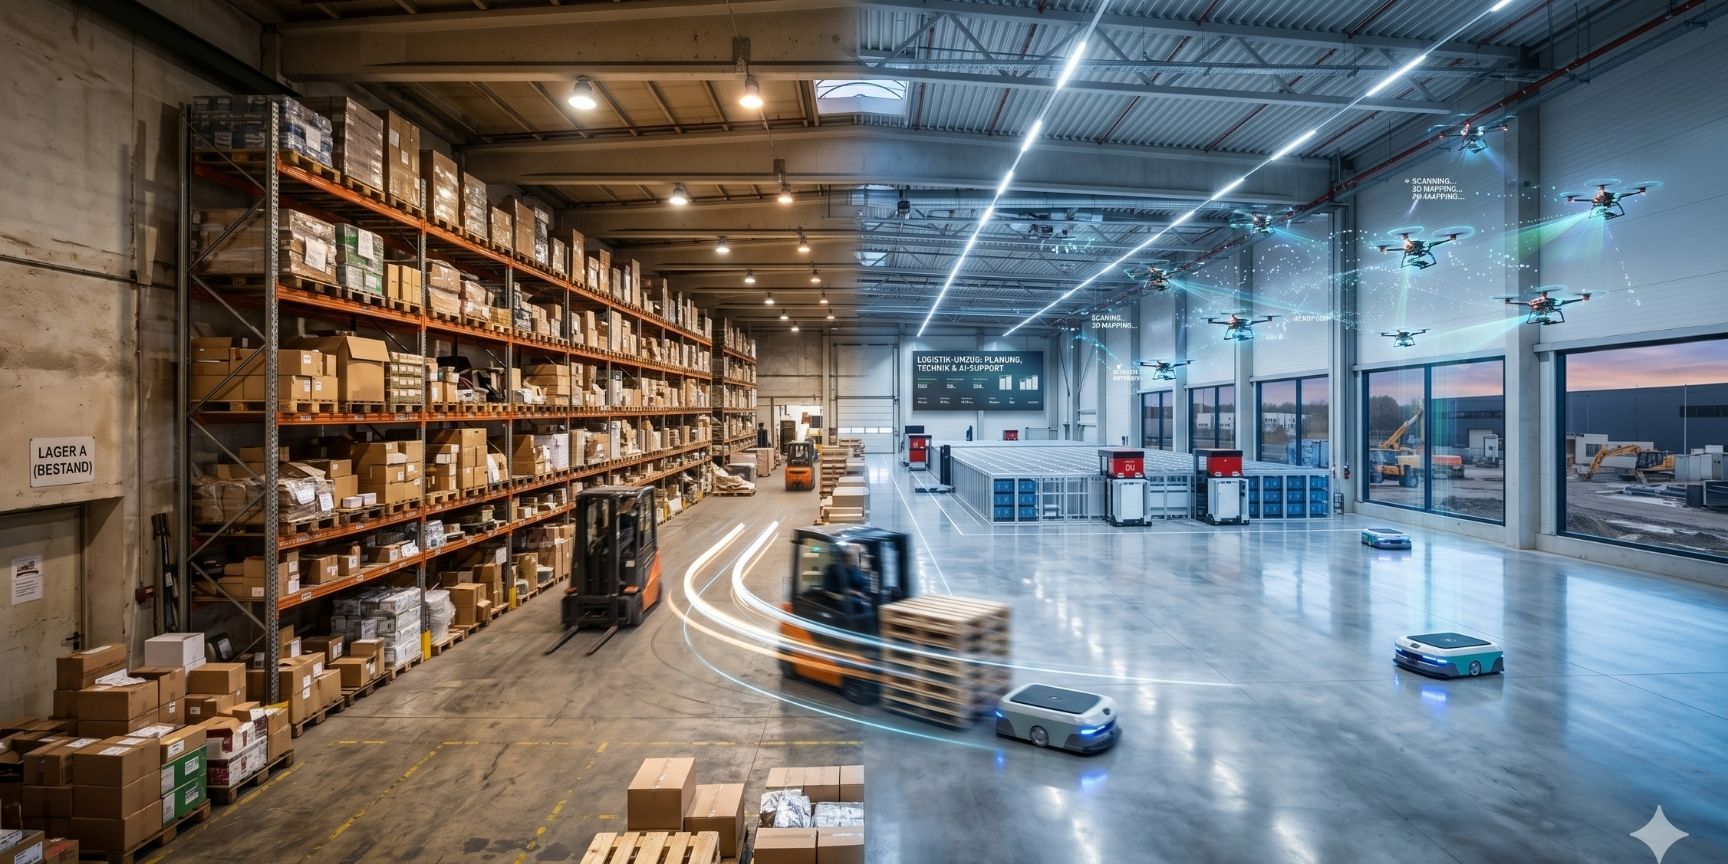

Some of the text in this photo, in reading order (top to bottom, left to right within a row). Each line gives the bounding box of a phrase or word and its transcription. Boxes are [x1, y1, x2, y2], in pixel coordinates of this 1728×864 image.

[917, 356, 1023, 365] LOGISTIK-UMZUG: PLANUNG,
[917, 364, 1004, 372] TECHNIK & AI-SUPPORT
[38, 445, 87, 459] LAGER A
[33, 460, 93, 480] (BESTAND)
